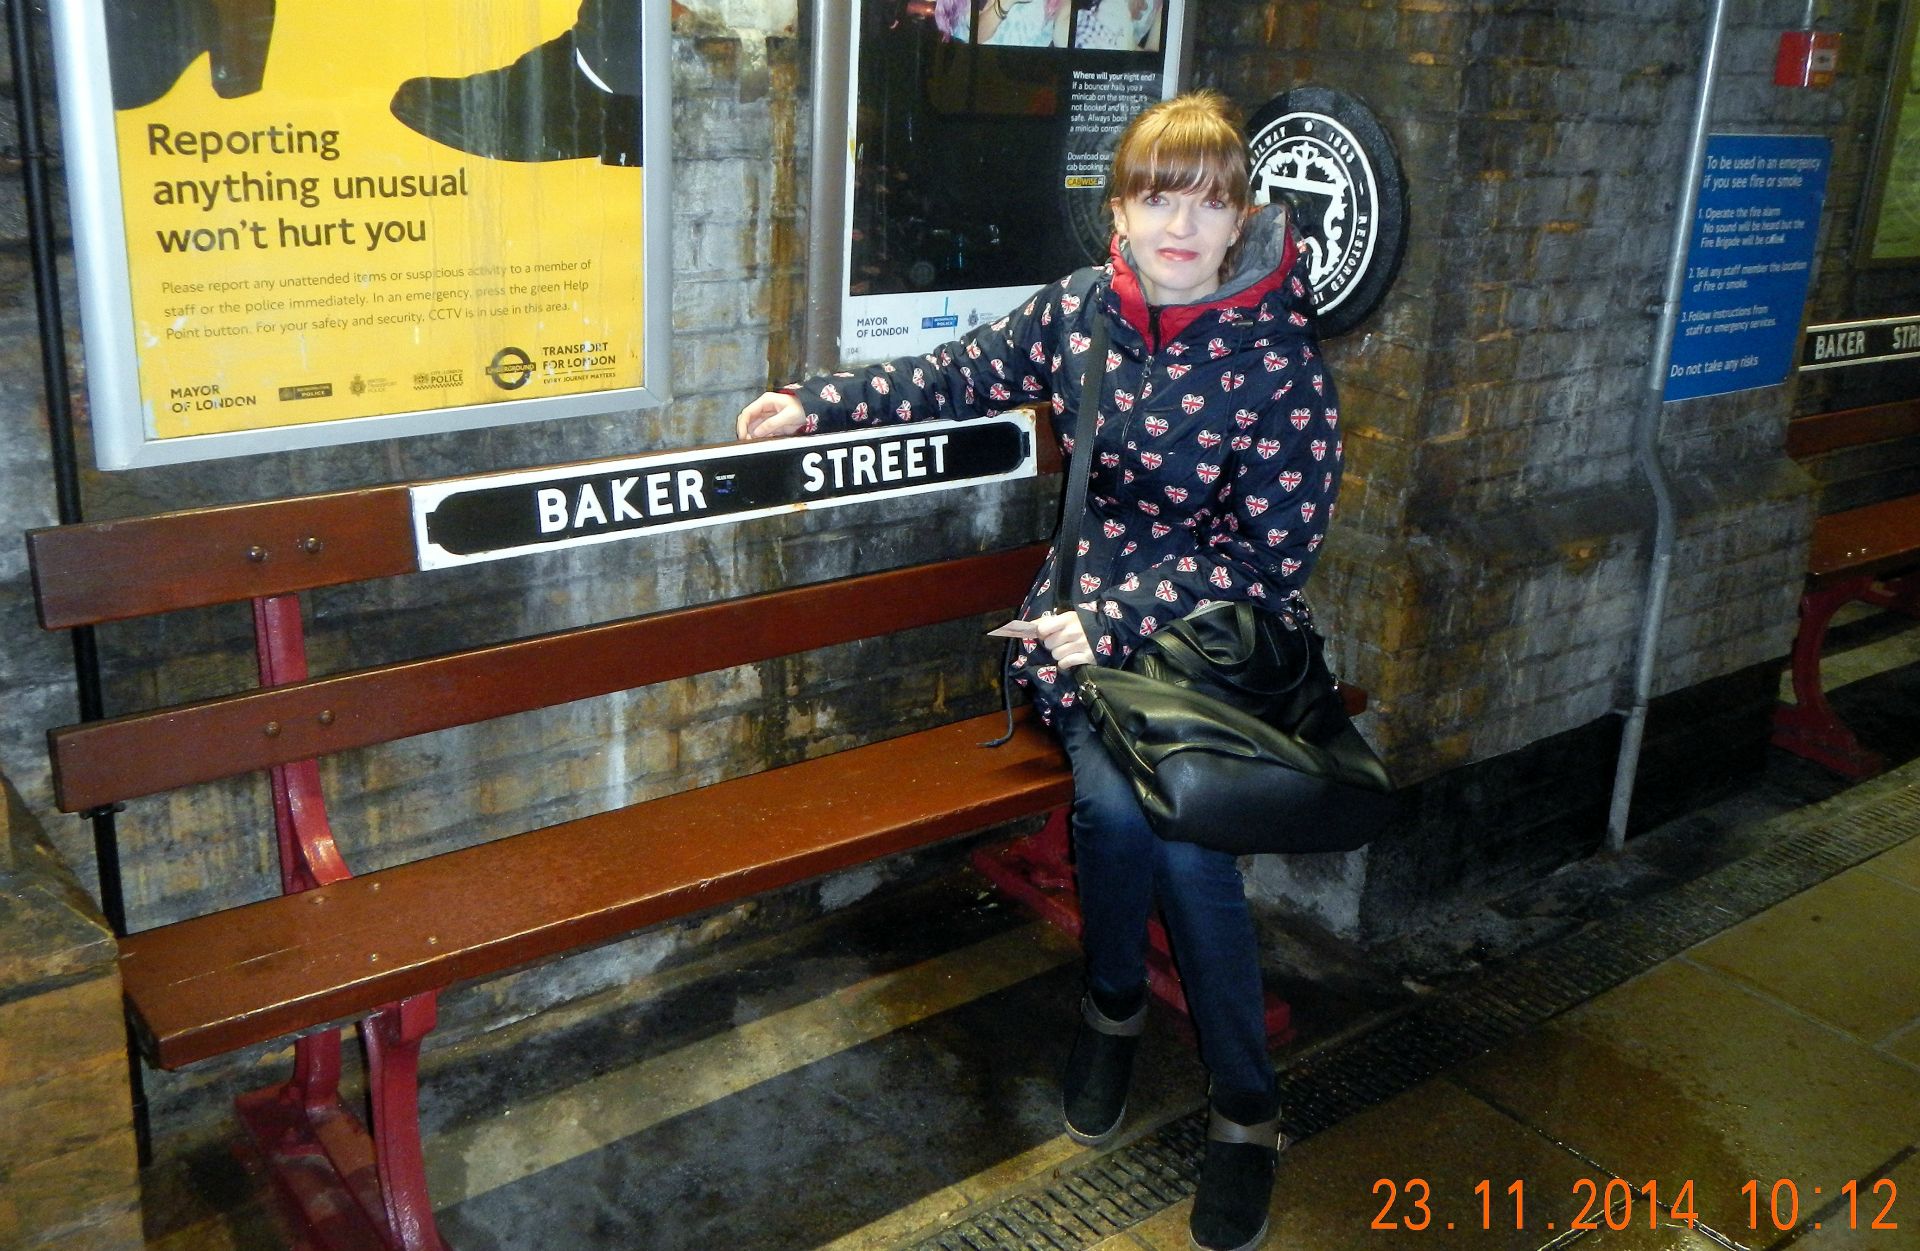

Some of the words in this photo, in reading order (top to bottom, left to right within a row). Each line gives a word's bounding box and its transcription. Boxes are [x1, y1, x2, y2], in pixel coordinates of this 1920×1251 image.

[1072, 70, 1095, 80] Where
[1096, 71, 1108, 80] will
[1109, 73, 1123, 82] your
[1124, 72, 1140, 82] night
[1141, 73, 1156, 81] end?
[1072, 82, 1078, 90] If
[1084, 82, 1110, 91] bouncer
[1111, 83, 1126, 91] hails
[1126, 85, 1139, 94] you
[1072, 93, 1096, 101] minicab
[1107, 93, 1118, 101] the
[1083, 103, 1106, 112] booked
[1107, 103, 1120, 112] and
[1070, 114, 1086, 122] safe.
[1088, 114, 1111, 124] Always
[147, 122, 340, 164] Reporting
[1250, 126, 1286, 166] AILWAY
[1067, 152, 1099, 161] Download
[1707, 155, 1718, 170] To
[1719, 155, 1732, 170] be
[1733, 156, 1756, 170] used
[1756, 156, 1765, 170] in
[1766, 158, 1778, 170] an
[1779, 158, 1821, 173] emergency
[1066, 163, 1078, 171] cab
[1078, 163, 1104, 173] booking
[152, 170, 321, 213] anything
[332, 166, 469, 200] unusual
[1703, 174, 1712, 189] if
[1712, 177, 1730, 192] you
[1731, 177, 1748, 189] see
[1749, 173, 1766, 189] fire
[1766, 177, 1777, 188] or
[1777, 173, 1803, 188] smoke
[1705, 207, 1735, 221] Operate
[1736, 207, 1749, 218] the
[1749, 206, 1762, 218] fire
[1762, 206, 1782, 217] alarm
[1702, 222, 1715, 233] No
[1715, 222, 1738, 233] sound
[1738, 221, 1751, 232] will
[1751, 221, 1761, 232] be
[1761, 220, 1780, 231] heard
[1780, 220, 1793, 230] but
[1793, 220, 1805, 230] the
[156, 218, 269, 254] won't
[277, 217, 356, 249] hurt
[364, 219, 427, 252] you
[1700, 237, 1715, 249] Fire
[1715, 236, 1741, 250] Brigade
[1741, 234, 1755, 246] will
[1755, 234, 1764, 245] be
[1330, 215, 1368, 292] RESTORED
[161, 281, 205, 295] Please
[208, 279, 250, 295] report
[253, 278, 275, 292] any
[279, 271, 351, 288] unattended
[353, 271, 387, 283] items
[390, 271, 403, 281] or
[405, 267, 465, 282] suspicious
[467, 264, 507, 279] activity
[510, 263, 522, 275] to
[533, 259, 578, 273] member
[580, 258, 592, 270] of
[1696, 266, 1709, 279] Tell
[1710, 267, 1723, 279] any
[1723, 264, 1742, 276] staff
[1741, 264, 1769, 275] member
[1769, 262, 1781, 273] the
[1781, 261, 1808, 272] location
[1693, 281, 1702, 293] of
[1703, 280, 1716, 292] fire
[1717, 281, 1726, 291] or
[164, 304, 196, 318] staff
[200, 304, 214, 315] or
[219, 302, 241, 314] the
[245, 299, 285, 314] police
[289, 294, 369, 310] immediately.
[373, 292, 384, 303] In
[388, 293, 402, 303] an
[405, 288, 472, 303] emergency,
[475, 286, 506, 299] press
[509, 284, 527, 295] the
[530, 282, 561, 296] green
[563, 280, 589, 292] Help
[1688, 310, 1712, 322] Follow
[1712, 306, 1752, 319] instructions
[1752, 304, 1769, 316] from
[166, 326, 200, 341] Point
[204, 324, 252, 338] button.
[256, 322, 276, 335] For
[280, 320, 308, 336] your
[312, 317, 349, 332] safety
[352, 314, 374, 326] and
[378, 311, 425, 326] security,
[428, 308, 462, 321] CCTV
[465, 307, 475, 318] is
[476, 306, 488, 318] in
[490, 306, 510, 318] use
[512, 303, 522, 315] in
[524, 302, 543, 314] this
[546, 303, 571, 313] area.
[856, 316, 889, 327] MAYOR
[1685, 324, 1705, 337] staff
[1704, 324, 1714, 334] or
[1713, 320, 1751, 334] emergency
[856, 328, 869, 339] OF
[871, 326, 909, 338] LONDON
[542, 341, 609, 356] TRANSPORT
[1815, 330, 1866, 360] BAKER
[1892, 324, 1920, 350] STR
[542, 359, 565, 370] FOR
[567, 355, 616, 369] LONDON
[1670, 364, 1684, 378] Do
[1685, 362, 1702, 376] not
[1704, 360, 1723, 373] take
[1723, 359, 1739, 372] any
[1740, 355, 1760, 368] risks
[430, 374, 464, 384] POLICE
[563, 374, 589, 383] JOURNEY
[590, 372, 616, 380] MATTERS
[170, 384, 221, 399] MAYOR
[301, 390, 326, 398] POLICE
[171, 402, 191, 414] OF
[195, 395, 257, 411] LONDON
[537, 467, 708, 534] BAKER
[801, 433, 950, 493] STREET
